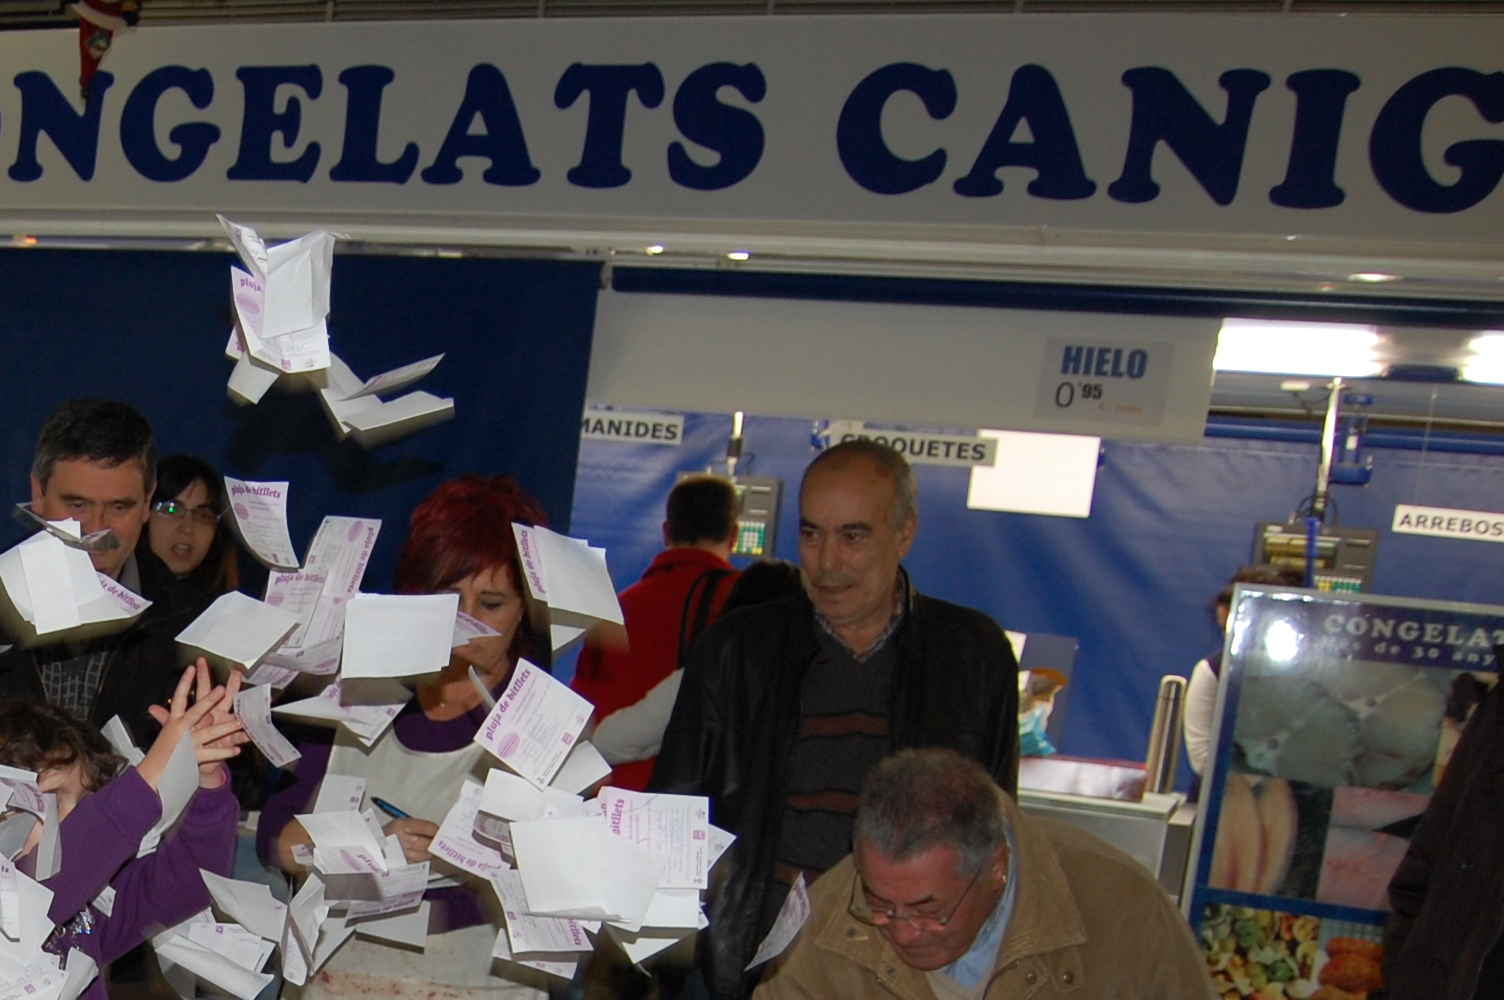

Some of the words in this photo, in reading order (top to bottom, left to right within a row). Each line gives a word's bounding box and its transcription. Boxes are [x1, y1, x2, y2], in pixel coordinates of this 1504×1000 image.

[240, 278, 262, 292] pluja
[1060, 345, 1148, 379] HIELO
[252, 485, 281, 499] bitllets
[485, 710, 503, 741] pluja
[499, 697, 511, 713] de
[507, 667, 532, 701] bitllets
